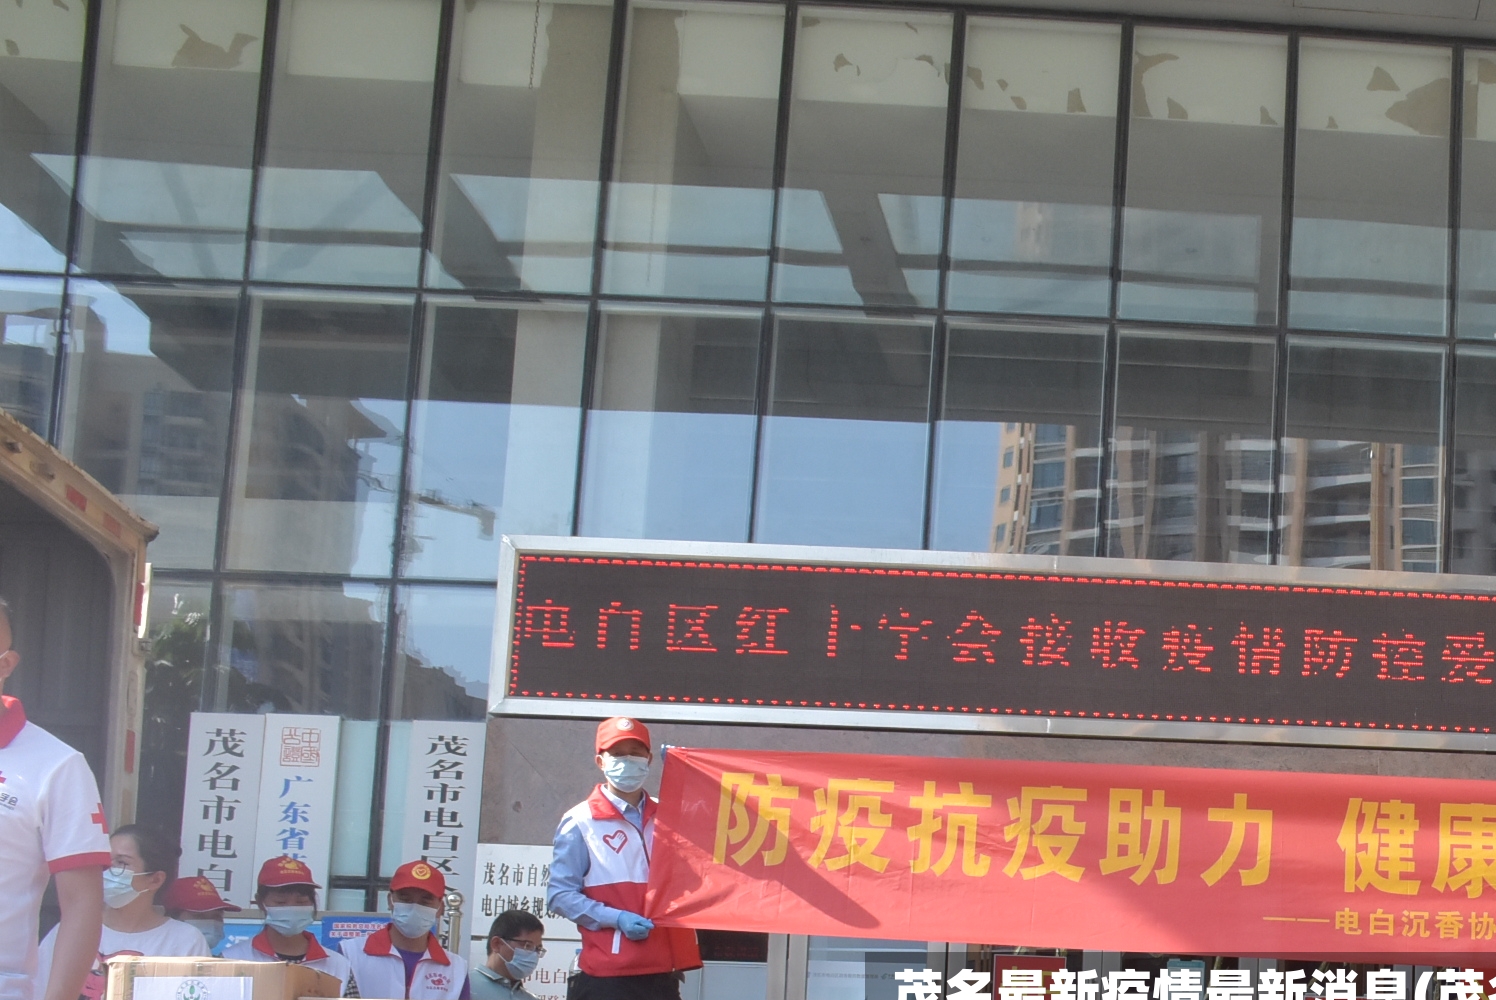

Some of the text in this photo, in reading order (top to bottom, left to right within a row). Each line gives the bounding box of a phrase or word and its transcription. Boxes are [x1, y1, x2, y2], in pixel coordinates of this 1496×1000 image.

[276, 776, 314, 860] 广东省
[712, 771, 1275, 888] 防疫抗疫助力
